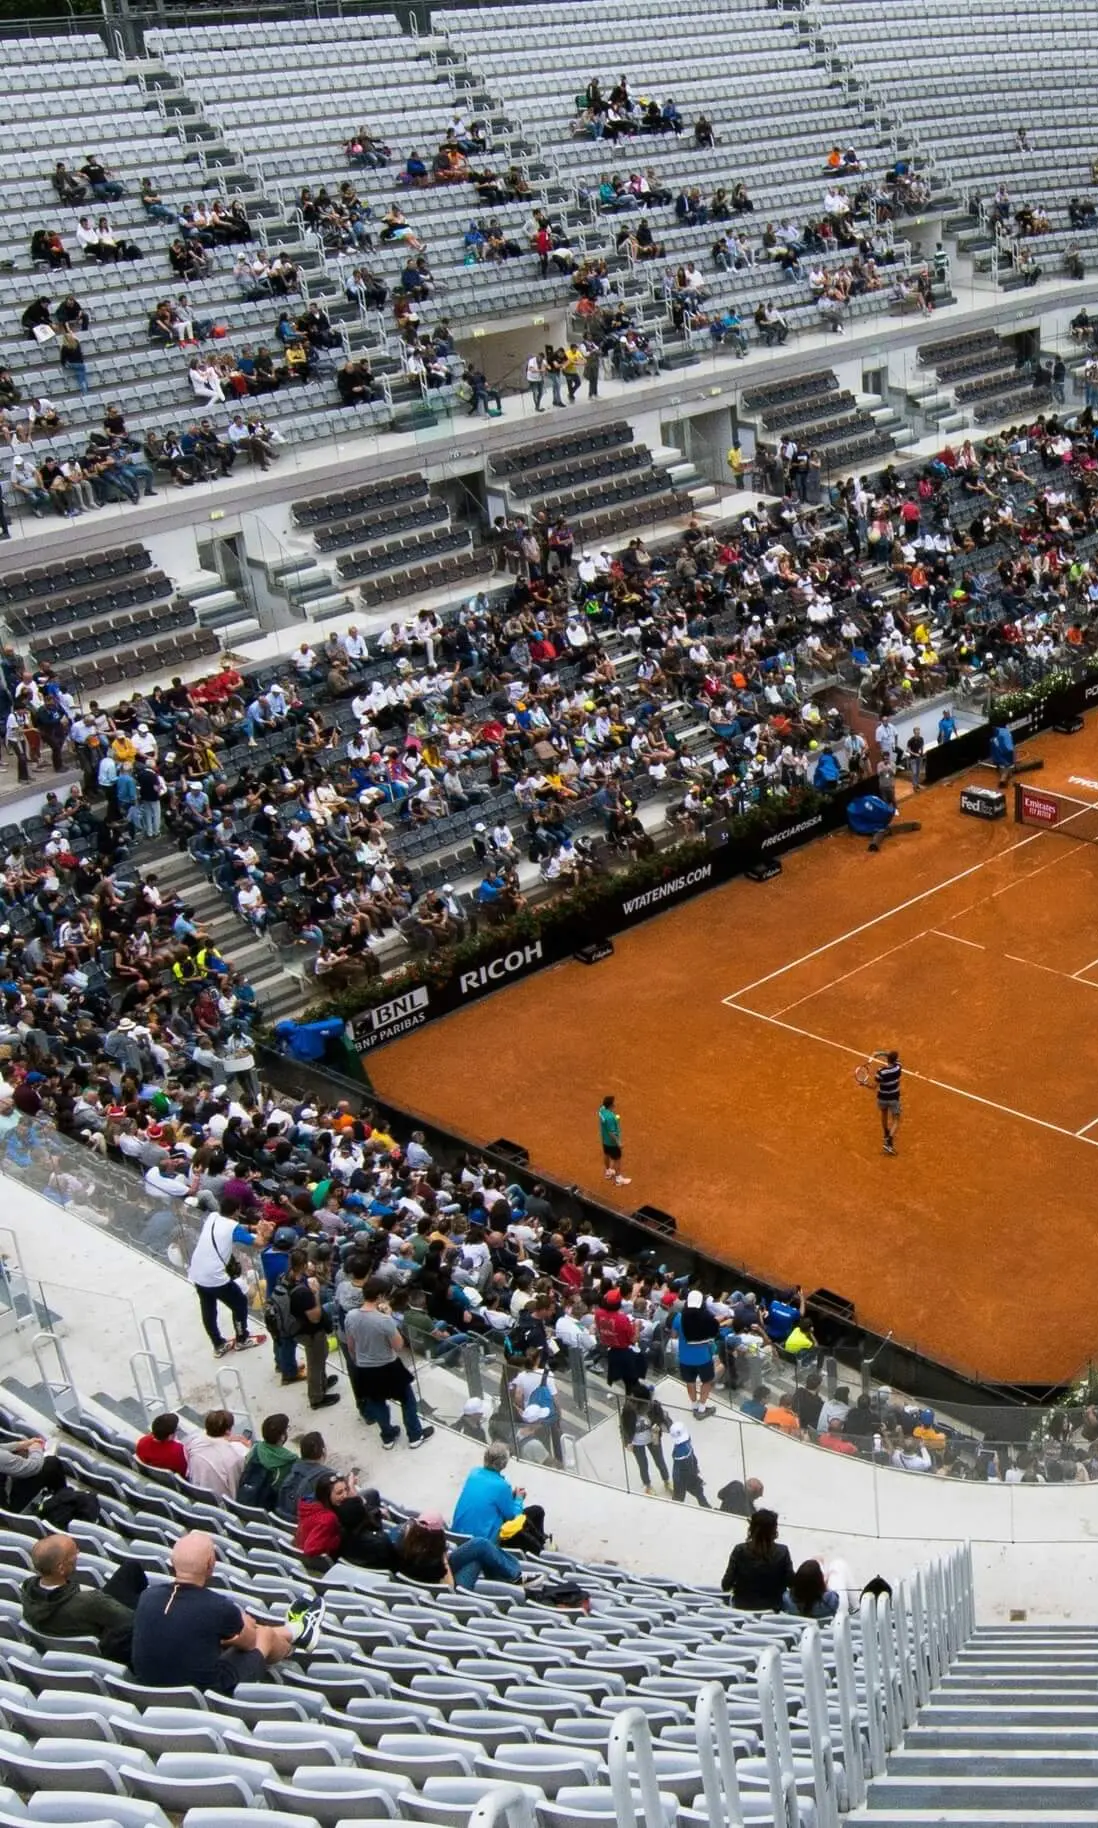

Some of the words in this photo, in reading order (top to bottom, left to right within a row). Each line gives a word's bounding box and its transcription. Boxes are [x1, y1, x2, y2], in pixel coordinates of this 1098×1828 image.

[1024, 798, 1056, 814] Emirates
[761, 815, 823, 849] FRECCIAROSSA
[622, 863, 712, 916] WTATENNIS.COM
[459, 940, 543, 994] RICOH
[376, 994, 423, 1025] BNL
[355, 1034, 377, 1053] BNP
[379, 1012, 426, 1041] PARIBAS
